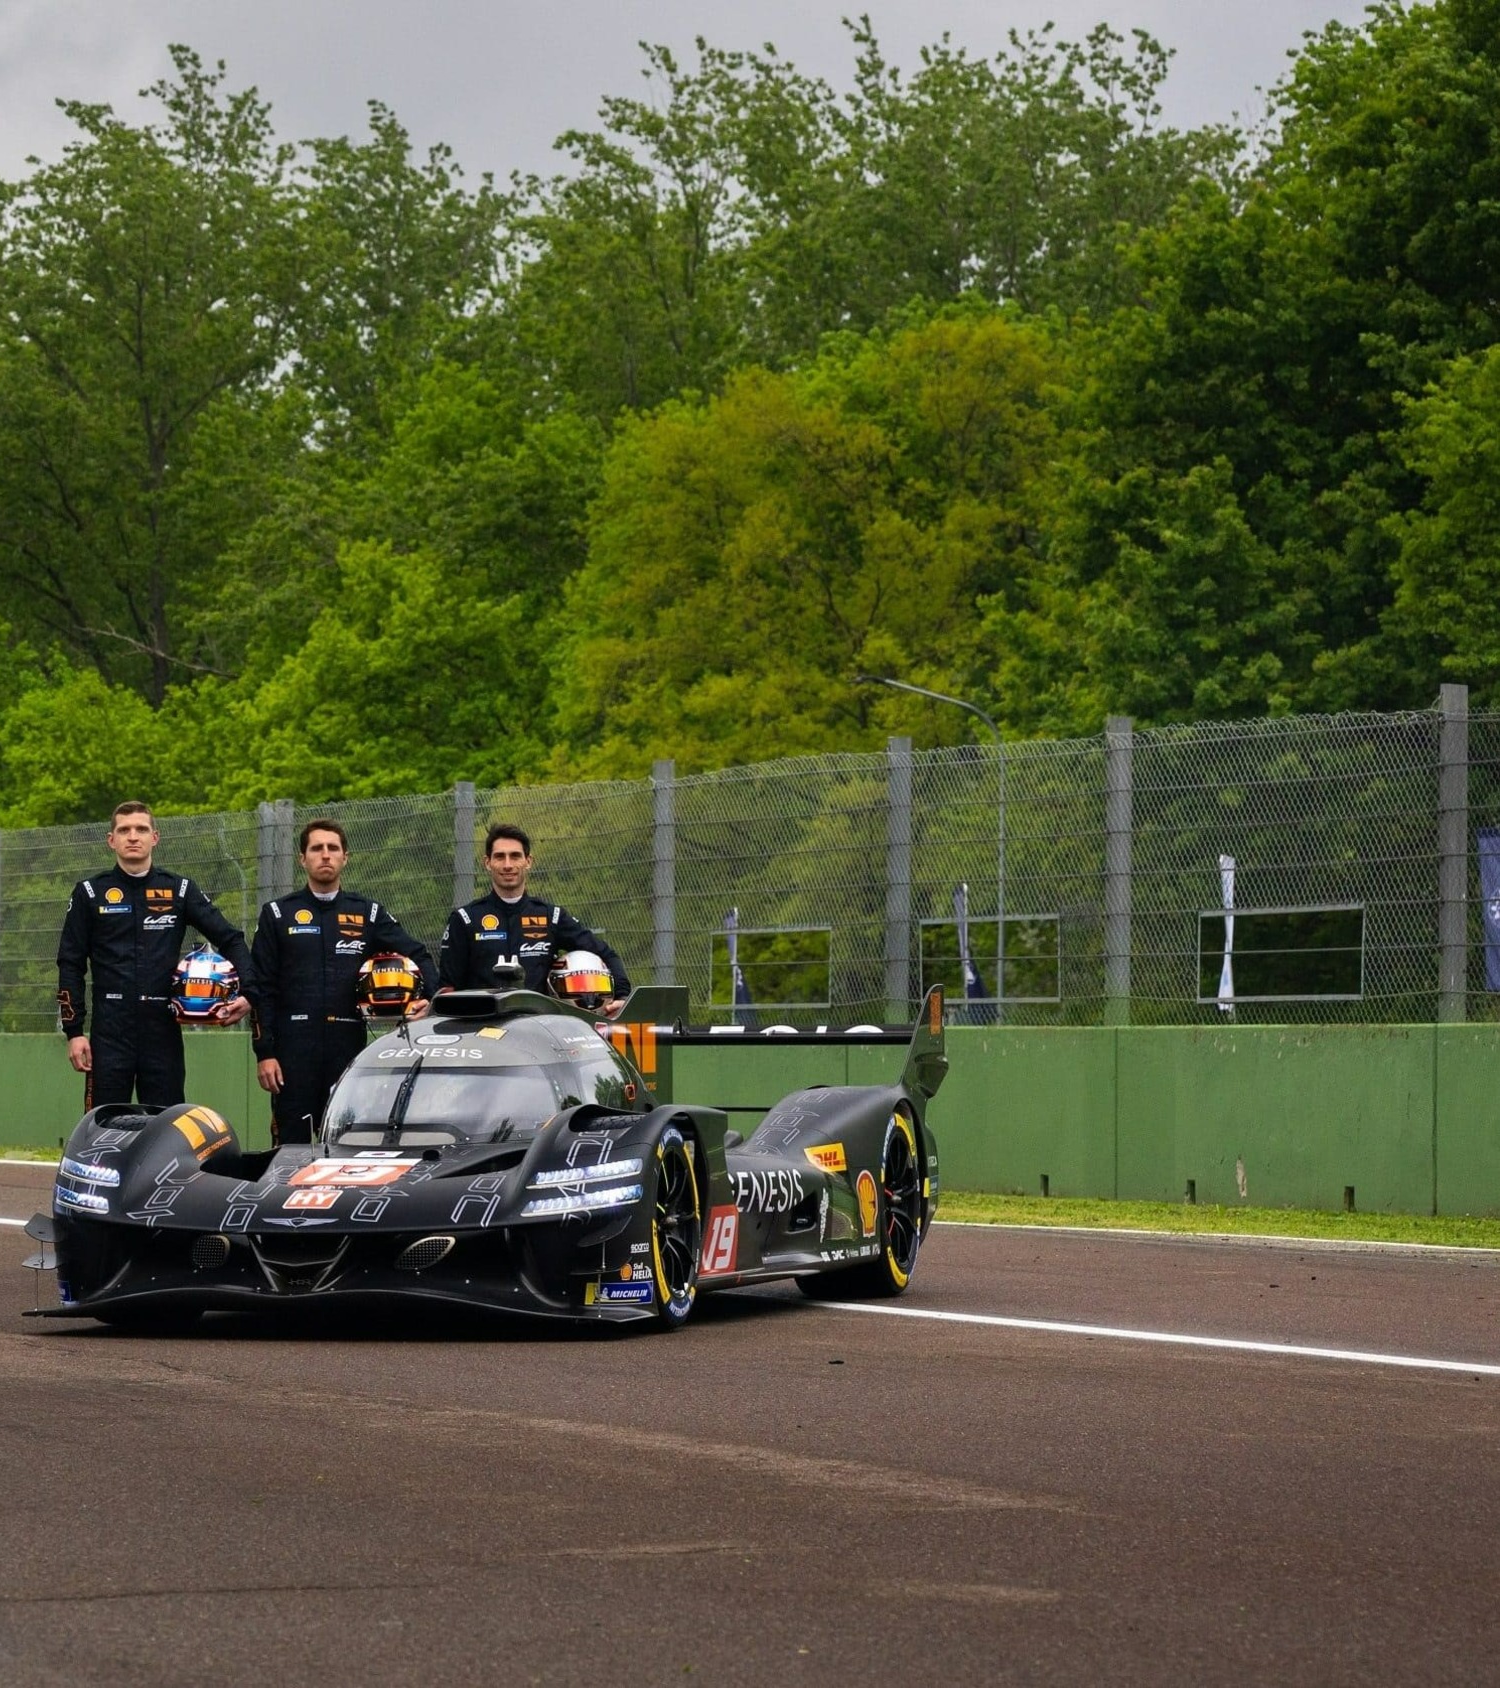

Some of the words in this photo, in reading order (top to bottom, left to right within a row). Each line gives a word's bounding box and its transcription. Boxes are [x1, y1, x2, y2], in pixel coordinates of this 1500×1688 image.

[143, 915, 177, 924] WEC
[335, 940, 366, 950] WEC
[520, 942, 551, 951] WEC
[378, 1048, 483, 1059] GENESIS
[813, 1151, 840, 1167] DHL
[727, 1168, 804, 1213] ENESIS
[289, 1191, 336, 1205] HY
[702, 1215, 736, 1270] 19
[632, 1266, 653, 1280] HELIX
[611, 1289, 648, 1298] MICHELIN
